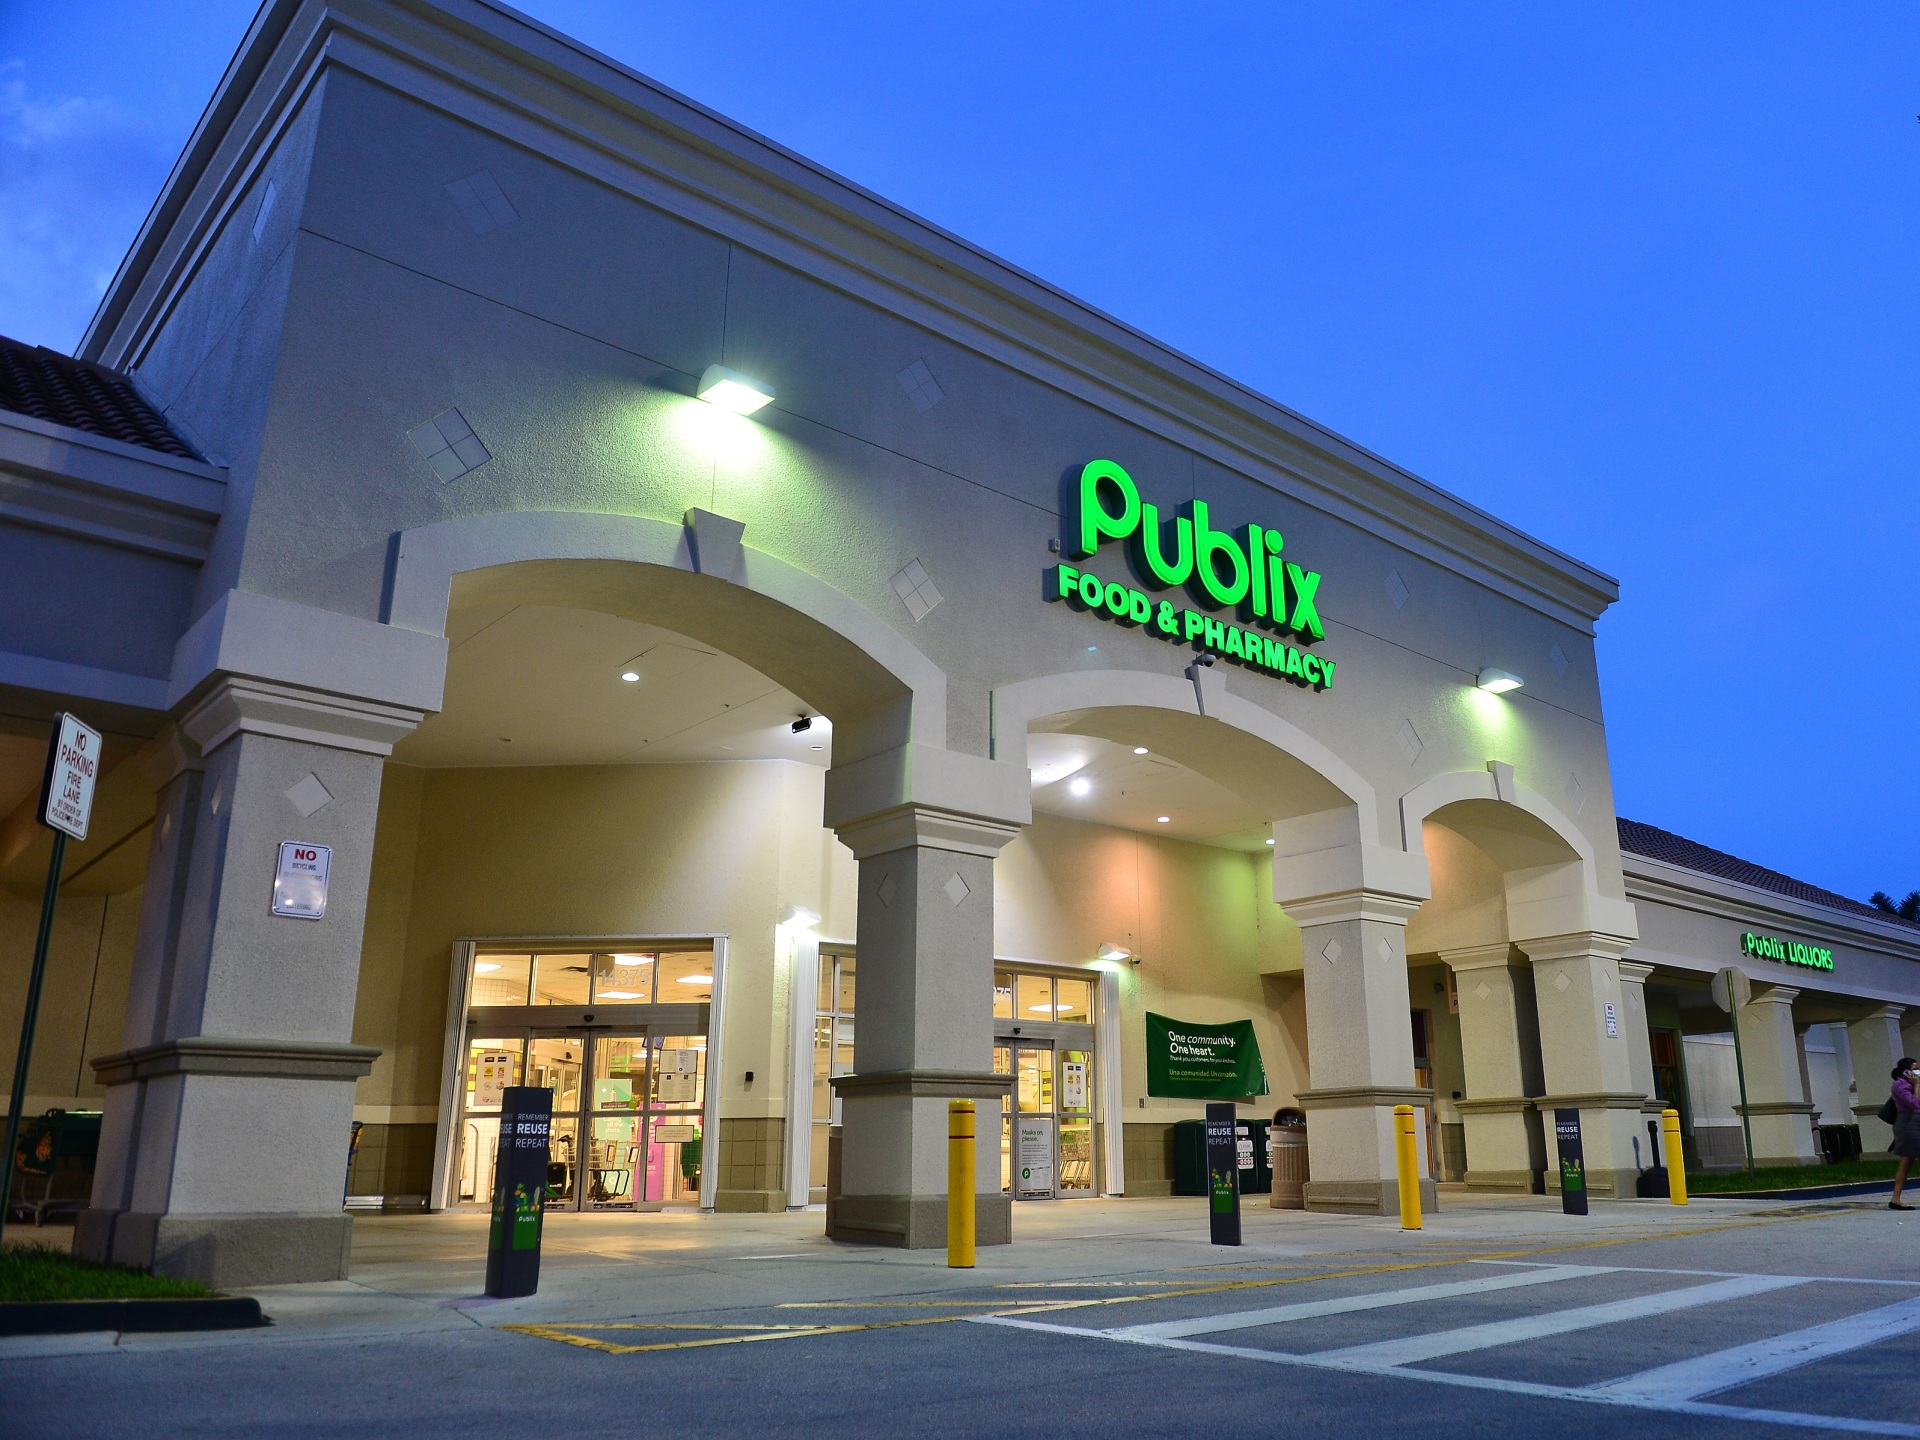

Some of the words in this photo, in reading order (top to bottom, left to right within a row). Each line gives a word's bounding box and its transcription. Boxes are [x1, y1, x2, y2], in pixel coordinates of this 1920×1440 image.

[1079, 459, 1325, 641] Publix
[1058, 563, 1151, 624] FOOD
[1157, 600, 1180, 636] &
[1184, 608, 1337, 689] PHARMACY
[75, 729, 87, 751] NO
[61, 744, 94, 778] PARKING
[67, 770, 82, 789] FIRE
[62, 785, 81, 805] LANE
[294, 849, 317, 861] NO
[292, 862, 317, 871] BICYCLING
[1747, 932, 1786, 960] Publix
[1788, 941, 1834, 970] LIQUORS
[1168, 1031, 1186, 1043] One
[1187, 1035, 1236, 1047] community.
[1170, 1042, 1189, 1054] One
[1189, 1044, 1215, 1056] heart.
[517, 1113, 549, 1121] REMEMBER
[516, 1123, 548, 1135] REUSE
[1208, 1127, 1232, 1136] REUSE
[515, 1138, 547, 1148] REPEAT
[1208, 1137, 1232, 1145] REPEAT
